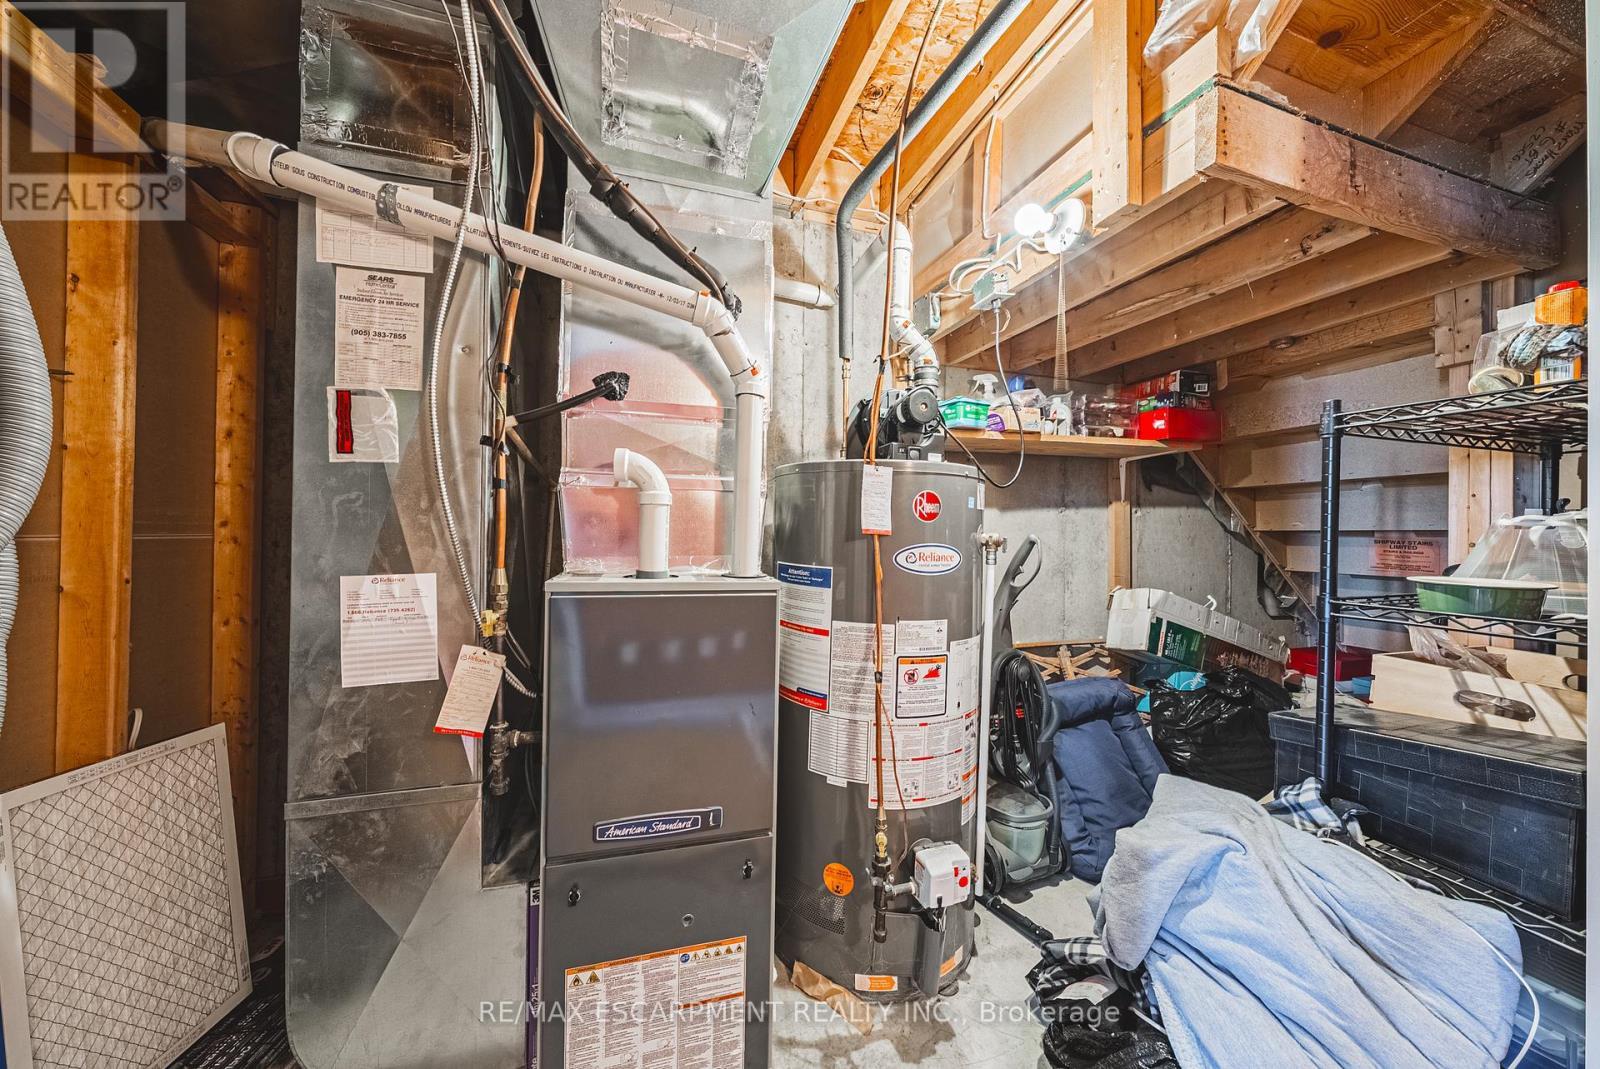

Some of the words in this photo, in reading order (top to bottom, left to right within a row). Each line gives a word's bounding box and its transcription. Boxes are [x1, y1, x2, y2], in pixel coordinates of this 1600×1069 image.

[307, 171, 346, 191] CONSTRUCTION
[396, 202, 412, 214] OLLOW
[414, 208, 452, 227] MANUFACTURERS
[551, 255, 582, 271] INSTRUCTIONS
[367, 274, 395, 283] SEARS
[339, 294, 377, 304] EMERGENCY
[351, 328, 371, 337] (905)
[918, 552, 955, 562] Reliance
[604, 823, 647, 838] American
[648, 817, 694, 833] Standard
